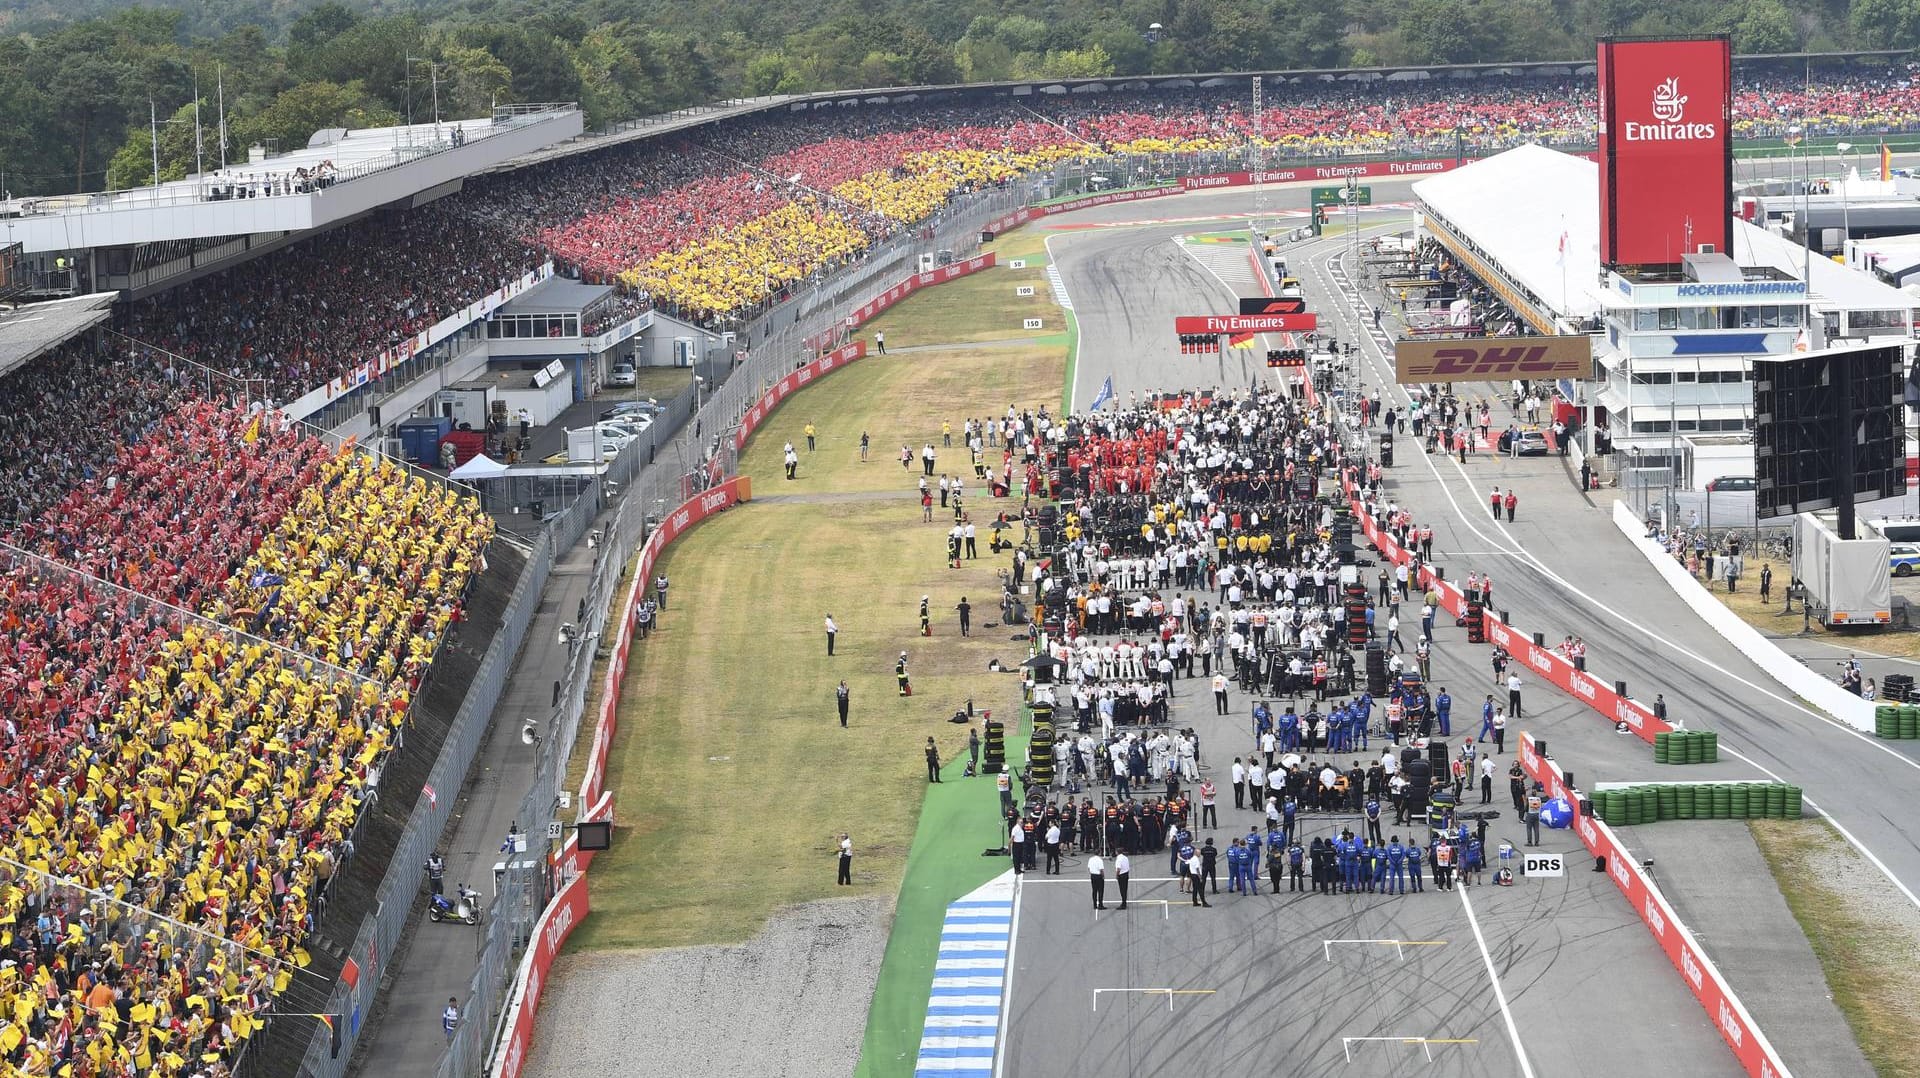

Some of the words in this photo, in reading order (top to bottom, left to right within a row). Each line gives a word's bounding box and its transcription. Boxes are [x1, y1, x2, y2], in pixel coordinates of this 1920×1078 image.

[1625, 121, 1715, 141] Emirates
[1317, 168, 1330, 177] Fly
[1390, 163, 1404, 173] Fly
[1406, 161, 1444, 172] Emirates
[1186, 178, 1199, 188] Fly
[1200, 176, 1229, 186] Emirates
[1262, 170, 1295, 181] Emirates
[1677, 282, 1806, 297] HOCKENHEIMRING
[1207, 318, 1228, 331] Fly
[1230, 317, 1285, 329] Emirates
[1431, 346, 1556, 375] DHL
[1535, 650, 1552, 673] Emirates
[1570, 671, 1578, 693] Fly
[1577, 675, 1595, 701] Emirates
[1616, 699, 1624, 721] Fly
[1624, 704, 1643, 729] Emirates
[550, 824, 560, 835] 58
[1527, 859, 1561, 871] DRS
[1725, 1007, 1742, 1048] Emirates
